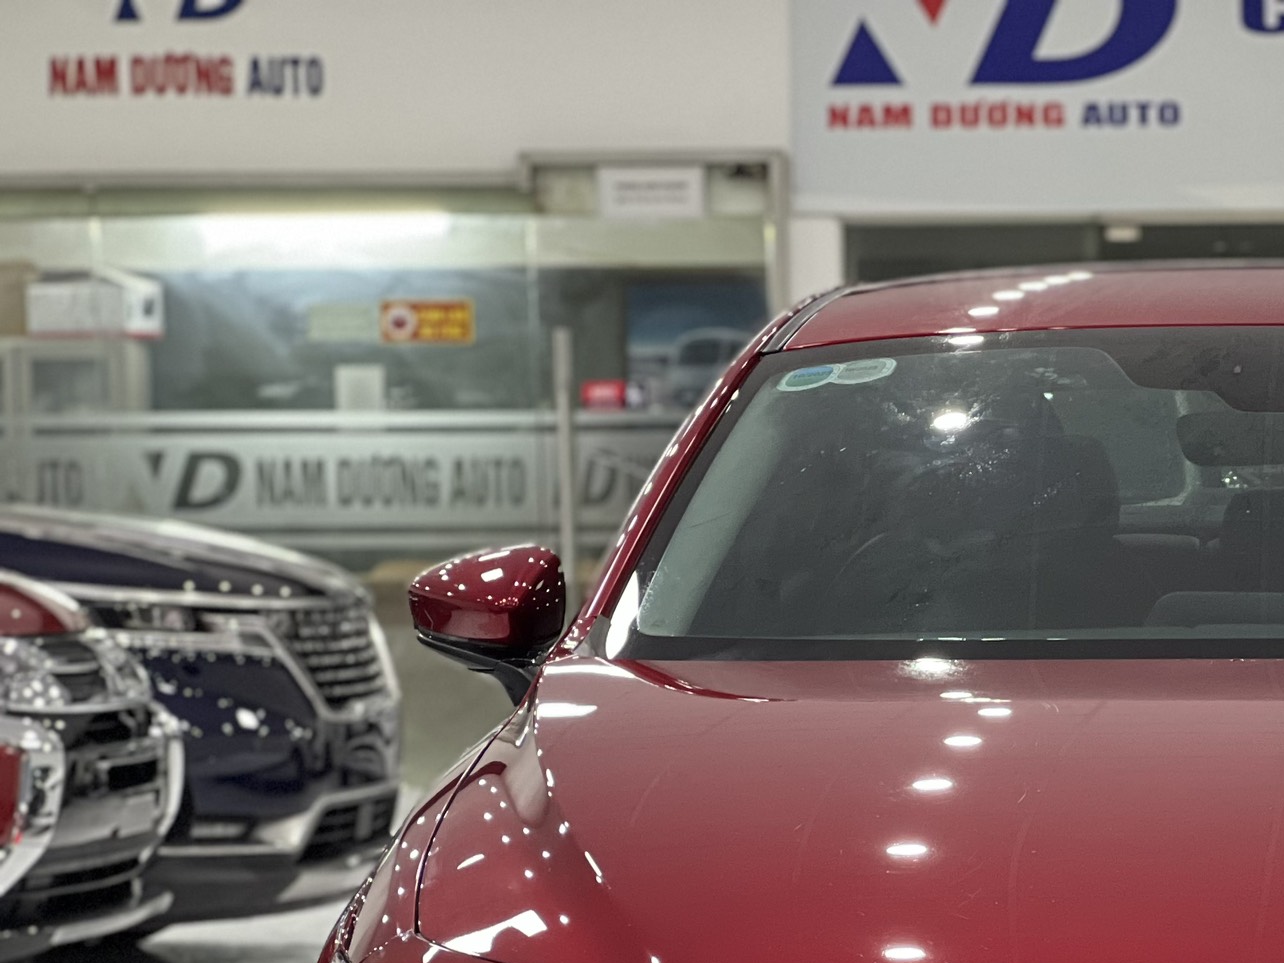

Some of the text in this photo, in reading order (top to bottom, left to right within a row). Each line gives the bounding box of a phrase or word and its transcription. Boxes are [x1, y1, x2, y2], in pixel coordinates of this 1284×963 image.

[49, 56, 119, 95] NAM
[248, 56, 324, 95] AUTO
[827, 103, 913, 129] NAM
[1081, 103, 1182, 127] AUTO
[256, 458, 327, 507] NAM
[452, 456, 526, 507] AUTO
